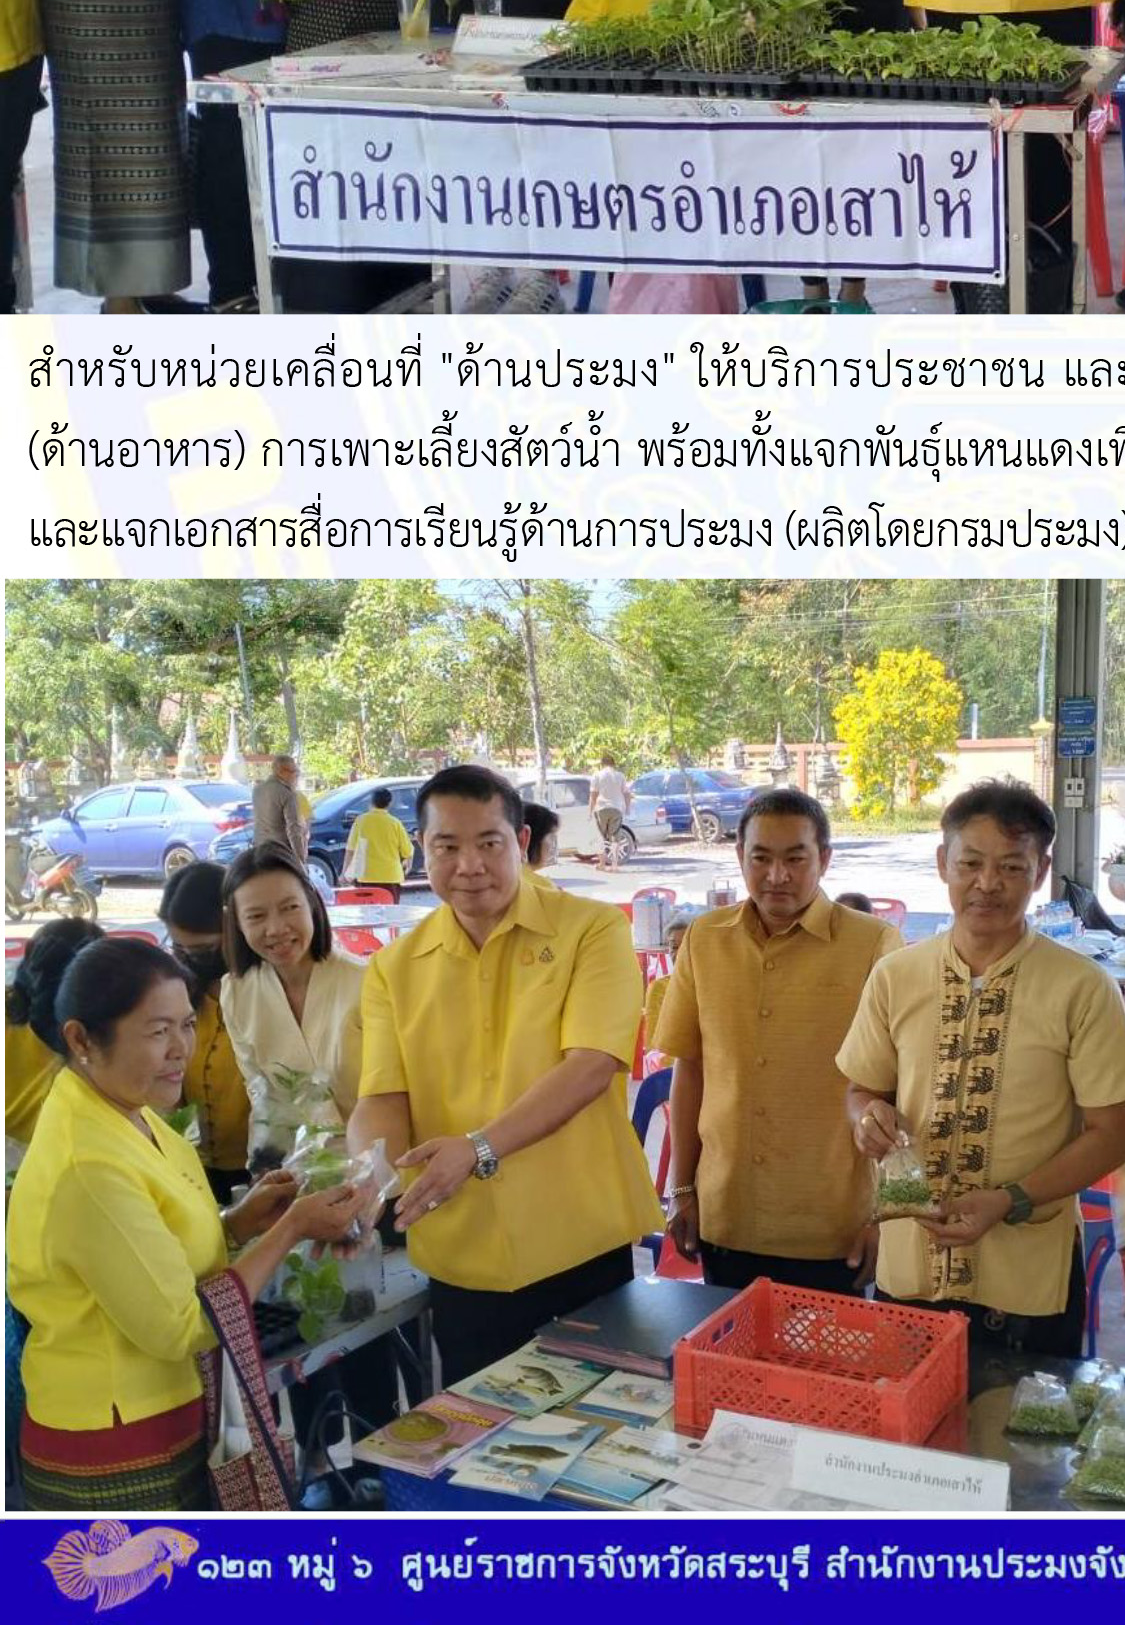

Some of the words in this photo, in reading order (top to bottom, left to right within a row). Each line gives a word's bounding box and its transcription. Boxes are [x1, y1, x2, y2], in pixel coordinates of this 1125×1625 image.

[288, 142, 979, 241] สำนักงานเกษตรอำเภอเสาไห้
